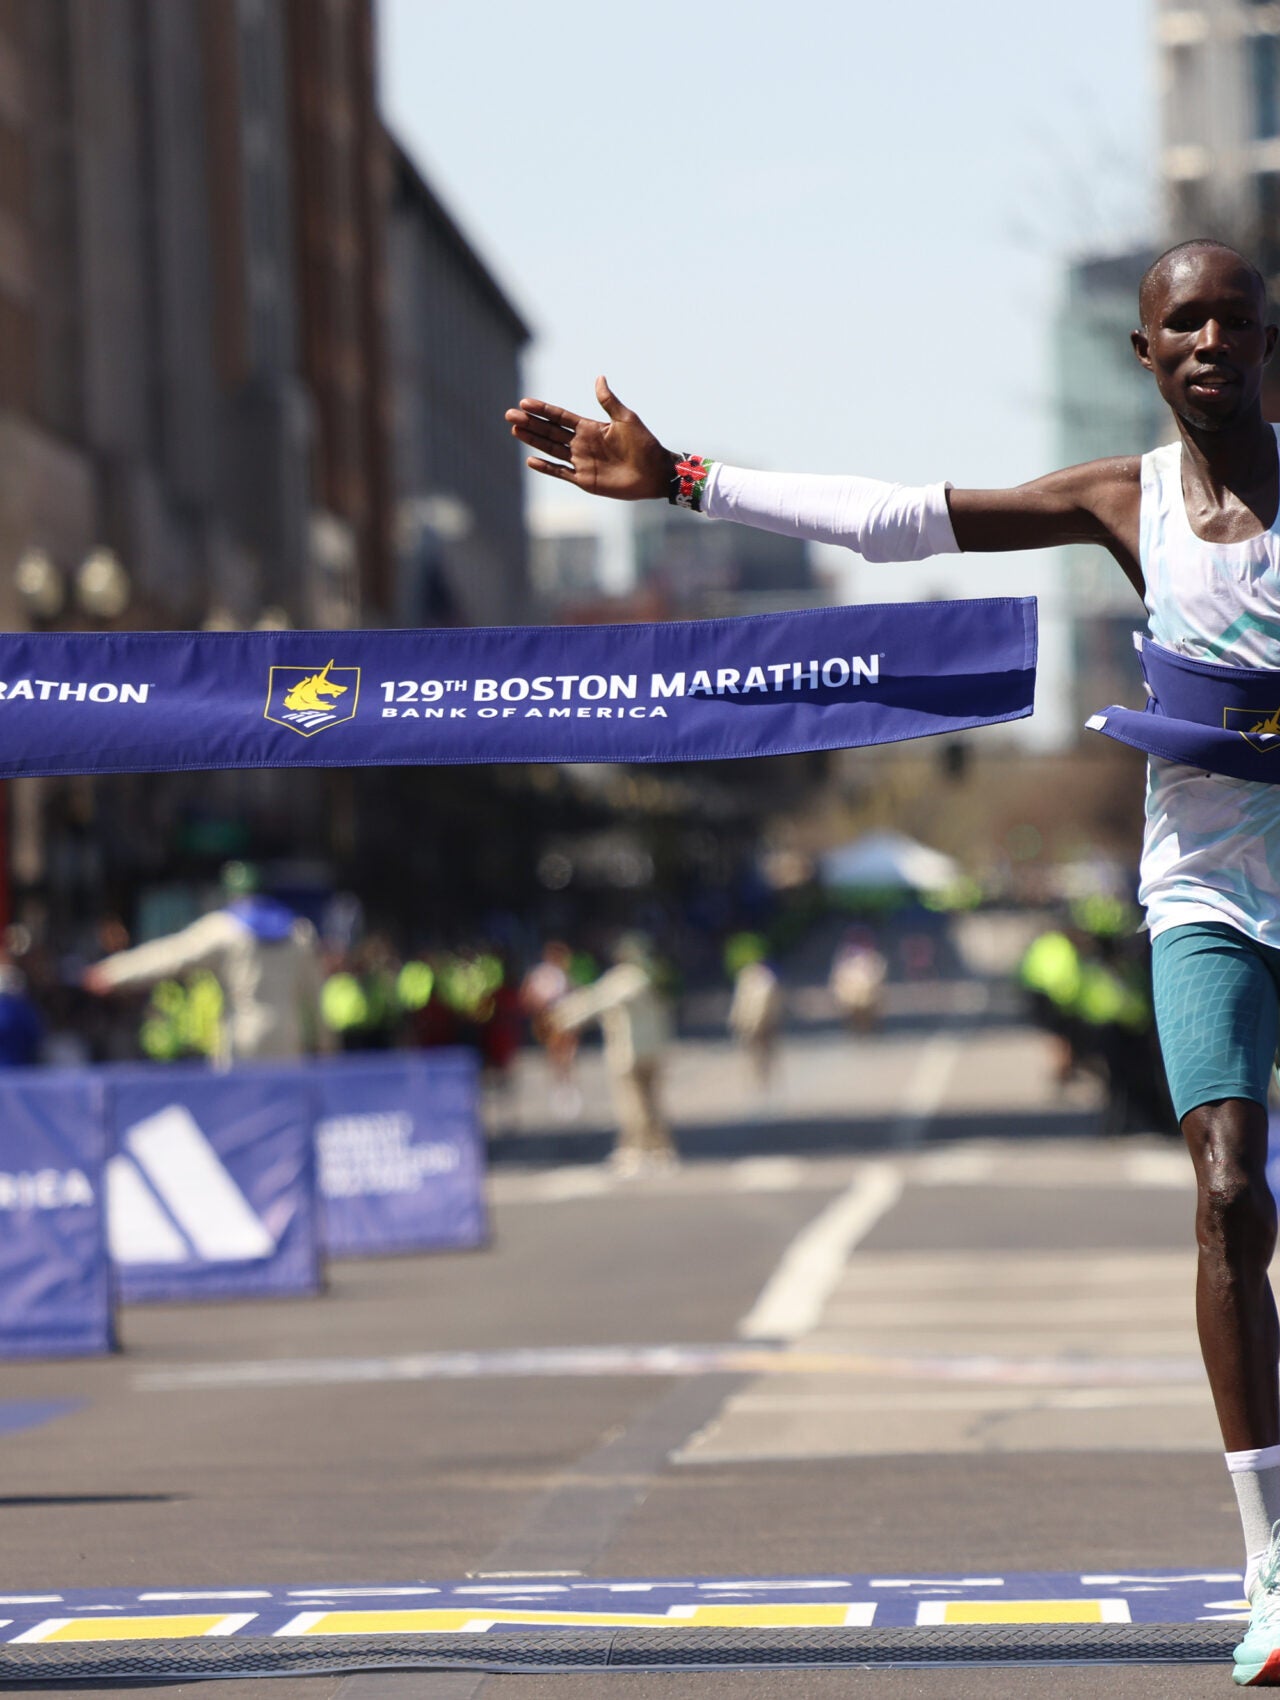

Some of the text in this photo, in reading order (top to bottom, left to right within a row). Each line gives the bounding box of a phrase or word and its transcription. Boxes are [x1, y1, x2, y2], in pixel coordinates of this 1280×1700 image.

[380, 653, 881, 703] 129TH BOSTON MARATHON
[381, 705, 669, 719] BANK OF AMERICA
